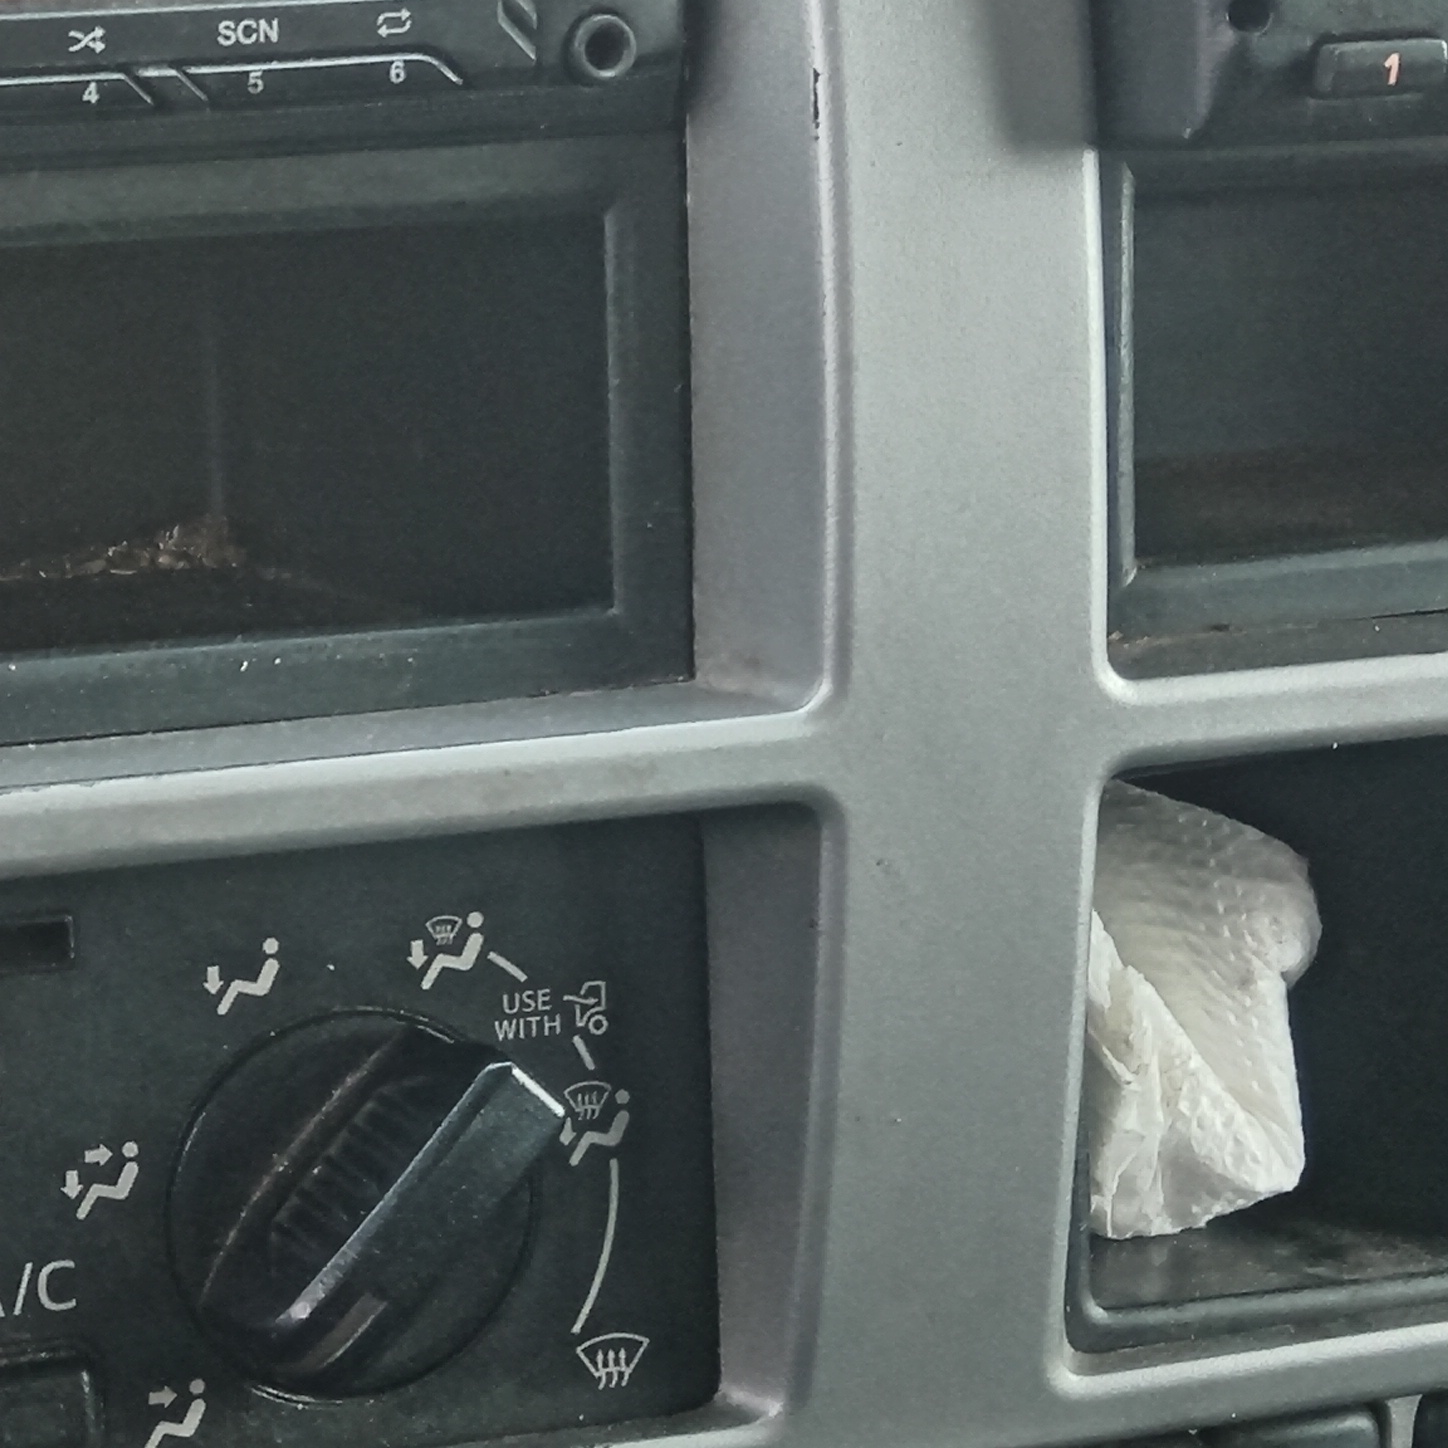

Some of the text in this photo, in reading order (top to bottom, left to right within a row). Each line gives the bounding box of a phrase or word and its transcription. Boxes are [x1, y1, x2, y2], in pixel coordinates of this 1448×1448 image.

[217, 18, 280, 47] SCN
[388, 61, 407, 84] 6
[1384, 53, 1403, 86] 1
[82, 81, 100, 105] 4
[247, 71, 264, 95] 5
[503, 988, 552, 1014] USE
[494, 1013, 561, 1042] WITH
